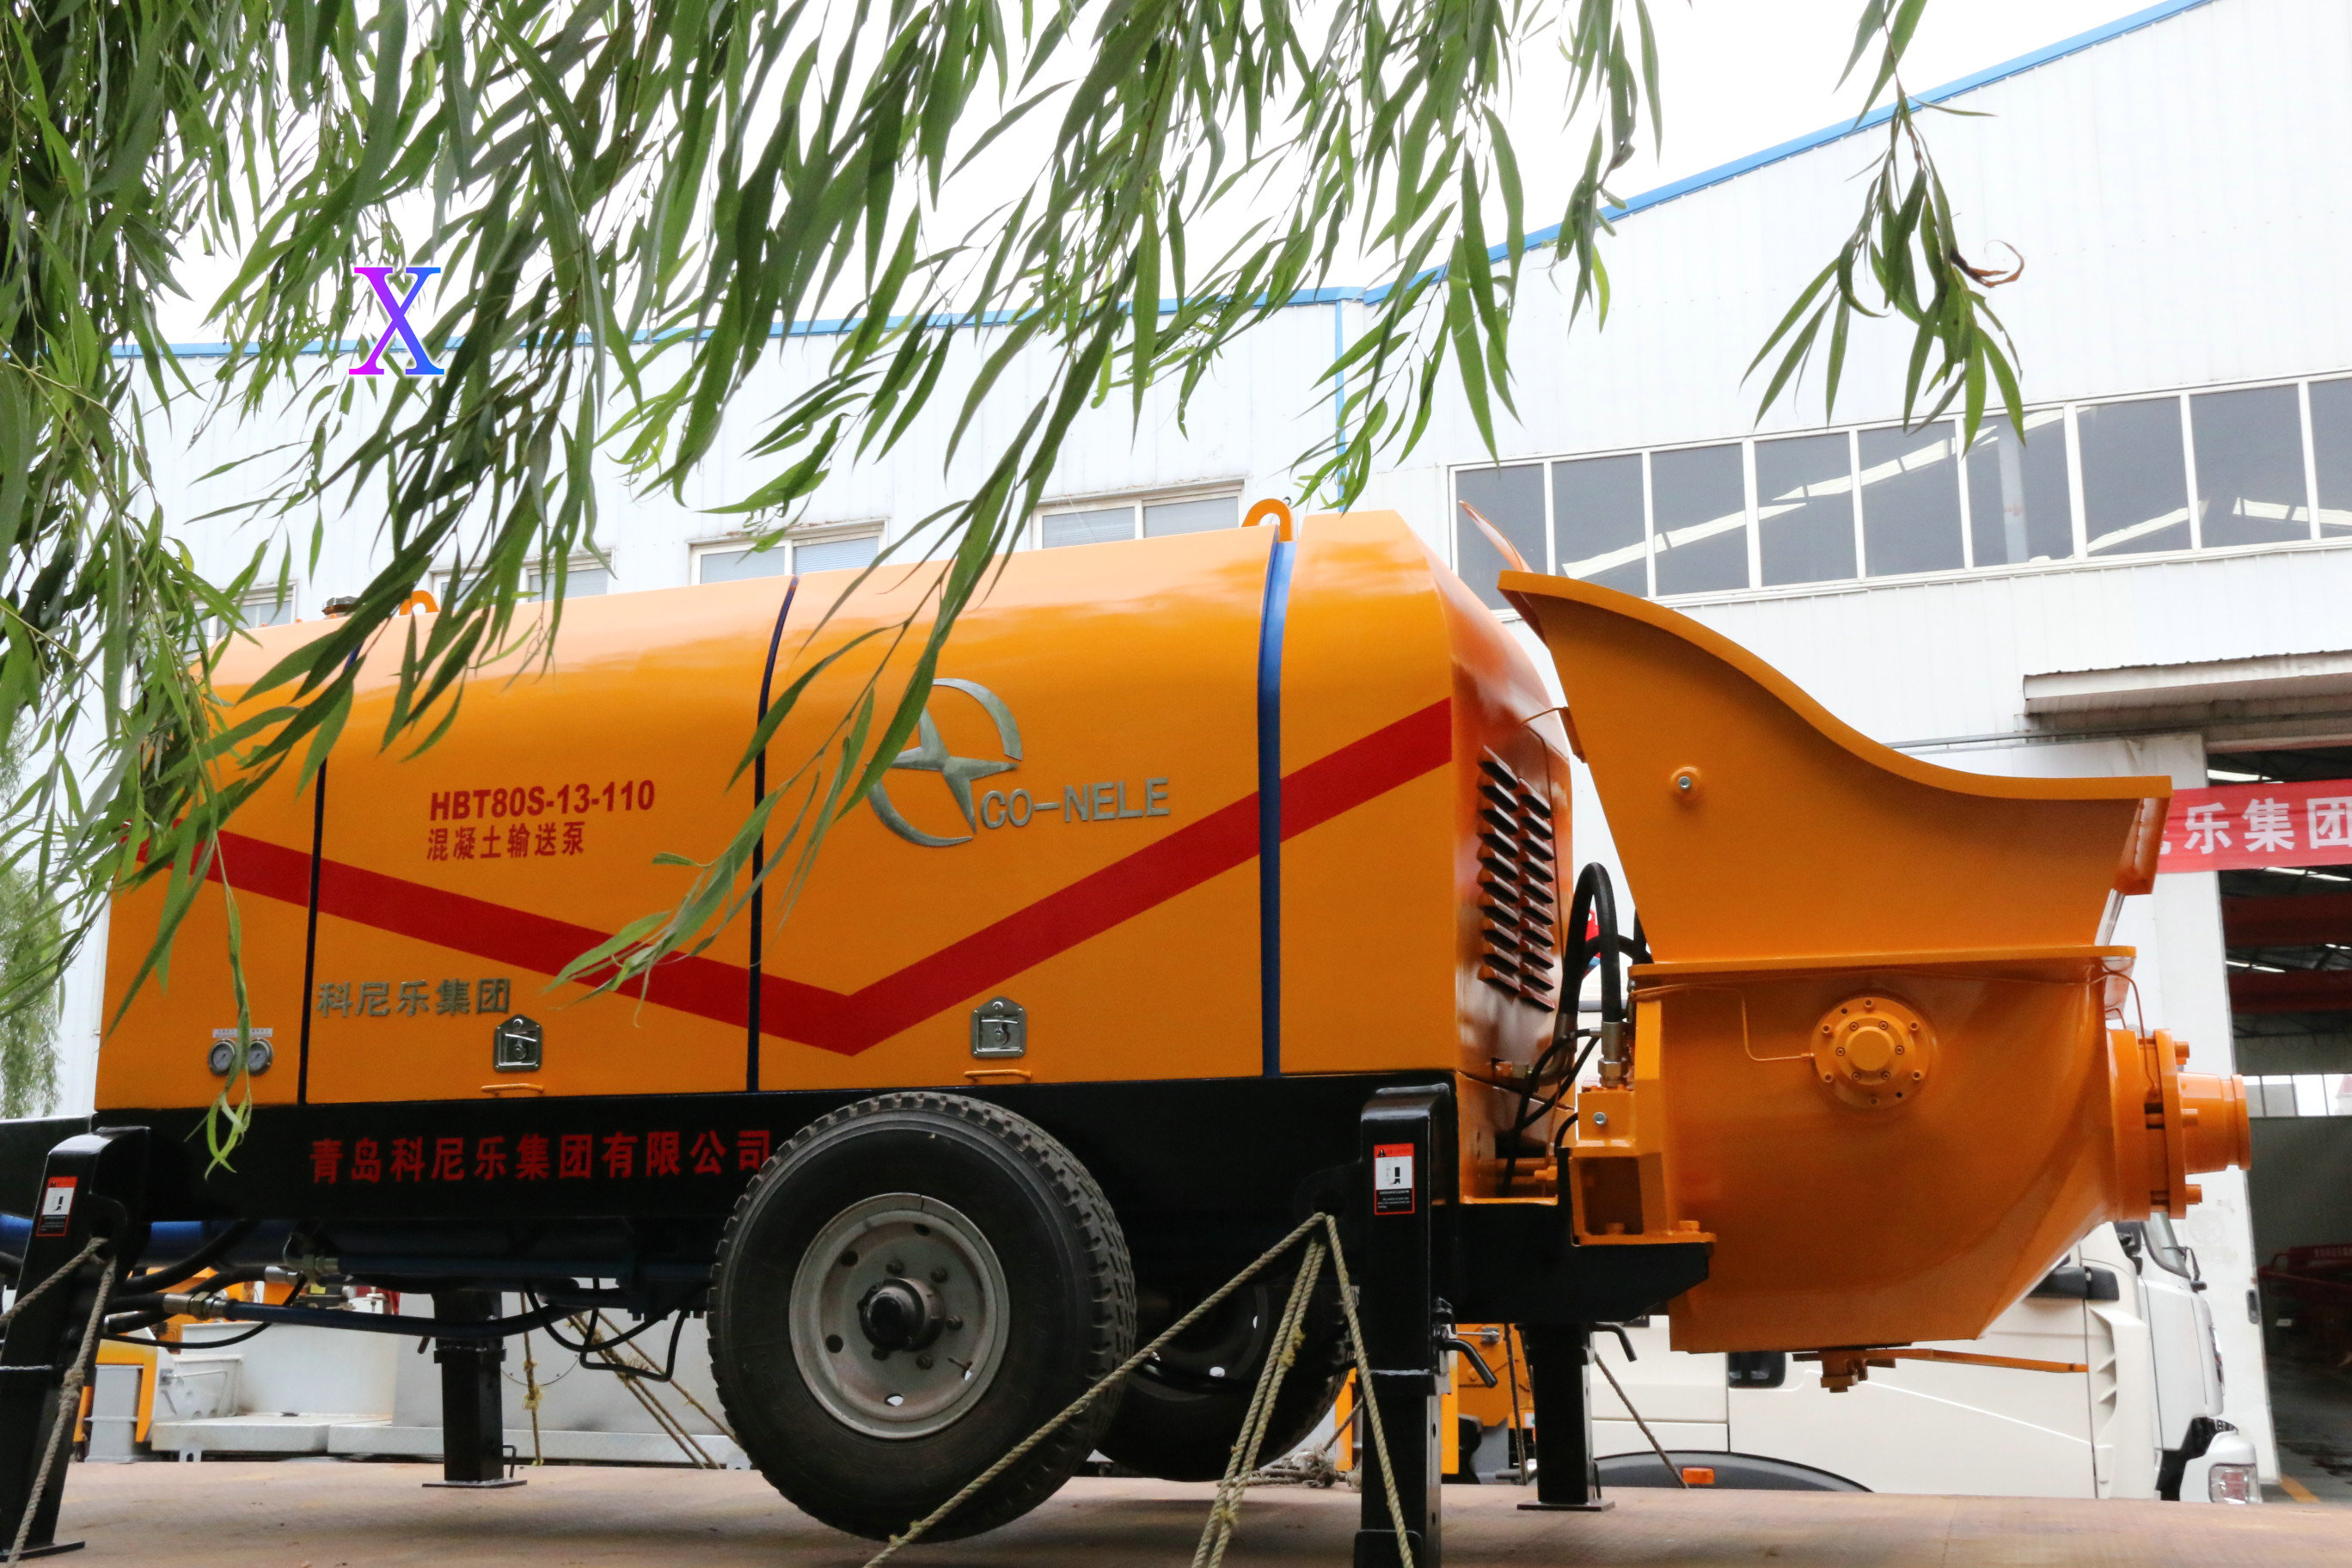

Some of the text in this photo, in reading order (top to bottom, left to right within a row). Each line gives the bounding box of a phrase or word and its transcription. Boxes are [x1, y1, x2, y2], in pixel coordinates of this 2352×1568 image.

[430, 779, 655, 821] HBT80S-13-110
[980, 777, 1171, 830] CO-NELE
[426, 821, 585, 861] 混凝土输送泵
[2159, 796, 2352, 854] 乐集团
[316, 977, 511, 1018] 科尼乐集团
[309, 1130, 770, 1184] 青岛科尼乐集团有限公司
